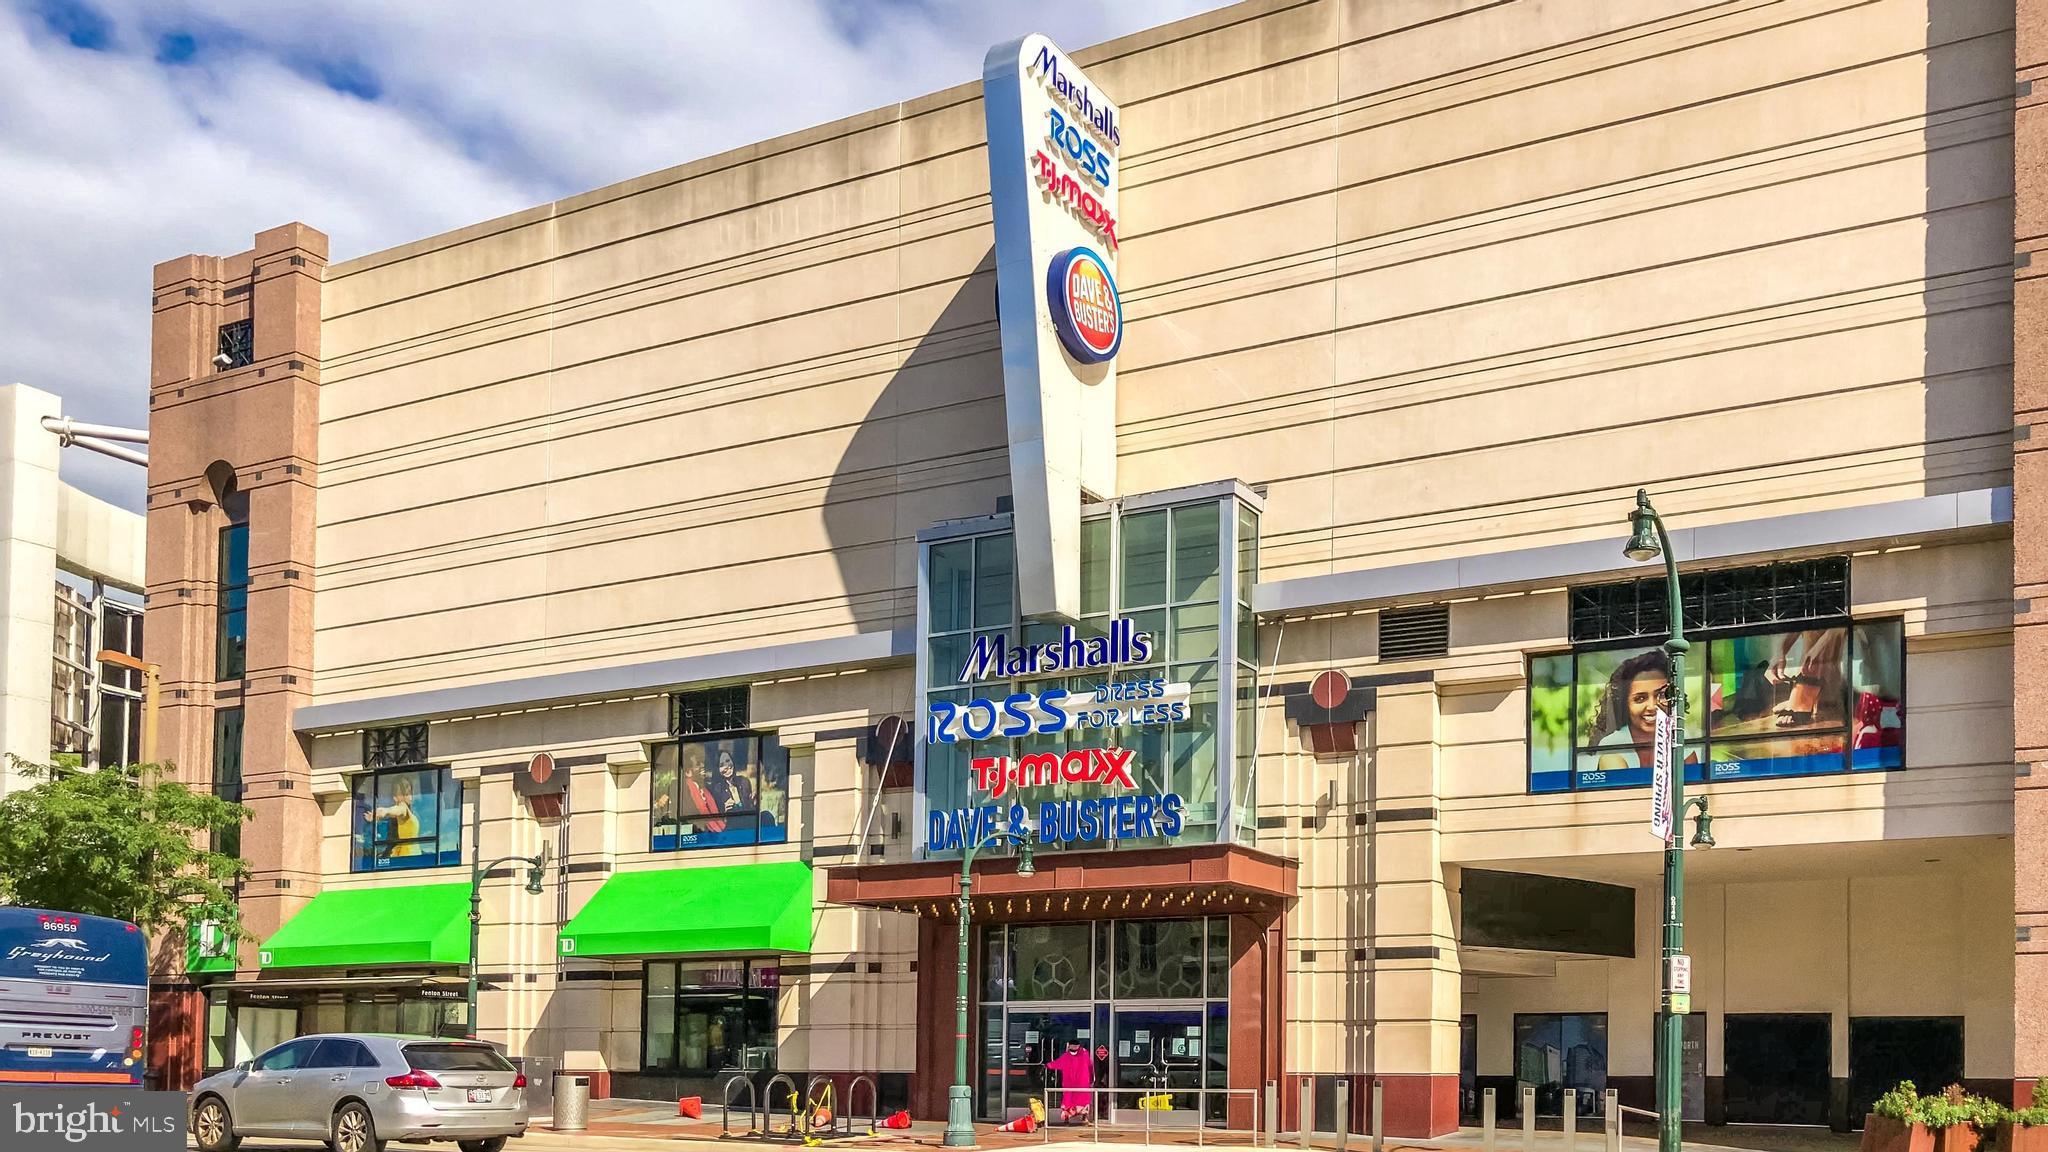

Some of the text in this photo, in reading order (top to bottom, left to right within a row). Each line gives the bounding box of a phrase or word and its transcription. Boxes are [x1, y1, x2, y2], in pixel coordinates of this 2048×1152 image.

[1033, 46, 1120, 146] Marshalls
[1049, 107, 1110, 187] ROSS
[1073, 273, 1114, 313] DAVE &
[1073, 299, 1115, 334] BUSTER'S
[958, 618, 1151, 682] Marshalls
[1095, 678, 1166, 704] DRESS
[928, 689, 1071, 744] ROSS
[1077, 702, 1185, 730] FOR LESS
[1582, 772, 1606, 781] ROSS
[1653, 720, 1665, 828] SILVER SPRING
[1715, 762, 1740, 771] ROSS
[929, 793, 1186, 850] DAVE & BUSTER'S
[43, 922, 77, 933] 86959
[6, 946, 111, 962] Greyhound
[260, 951, 272, 965] TD
[560, 938, 574, 952] TD
[22, 1031, 91, 1040] PREVOST
